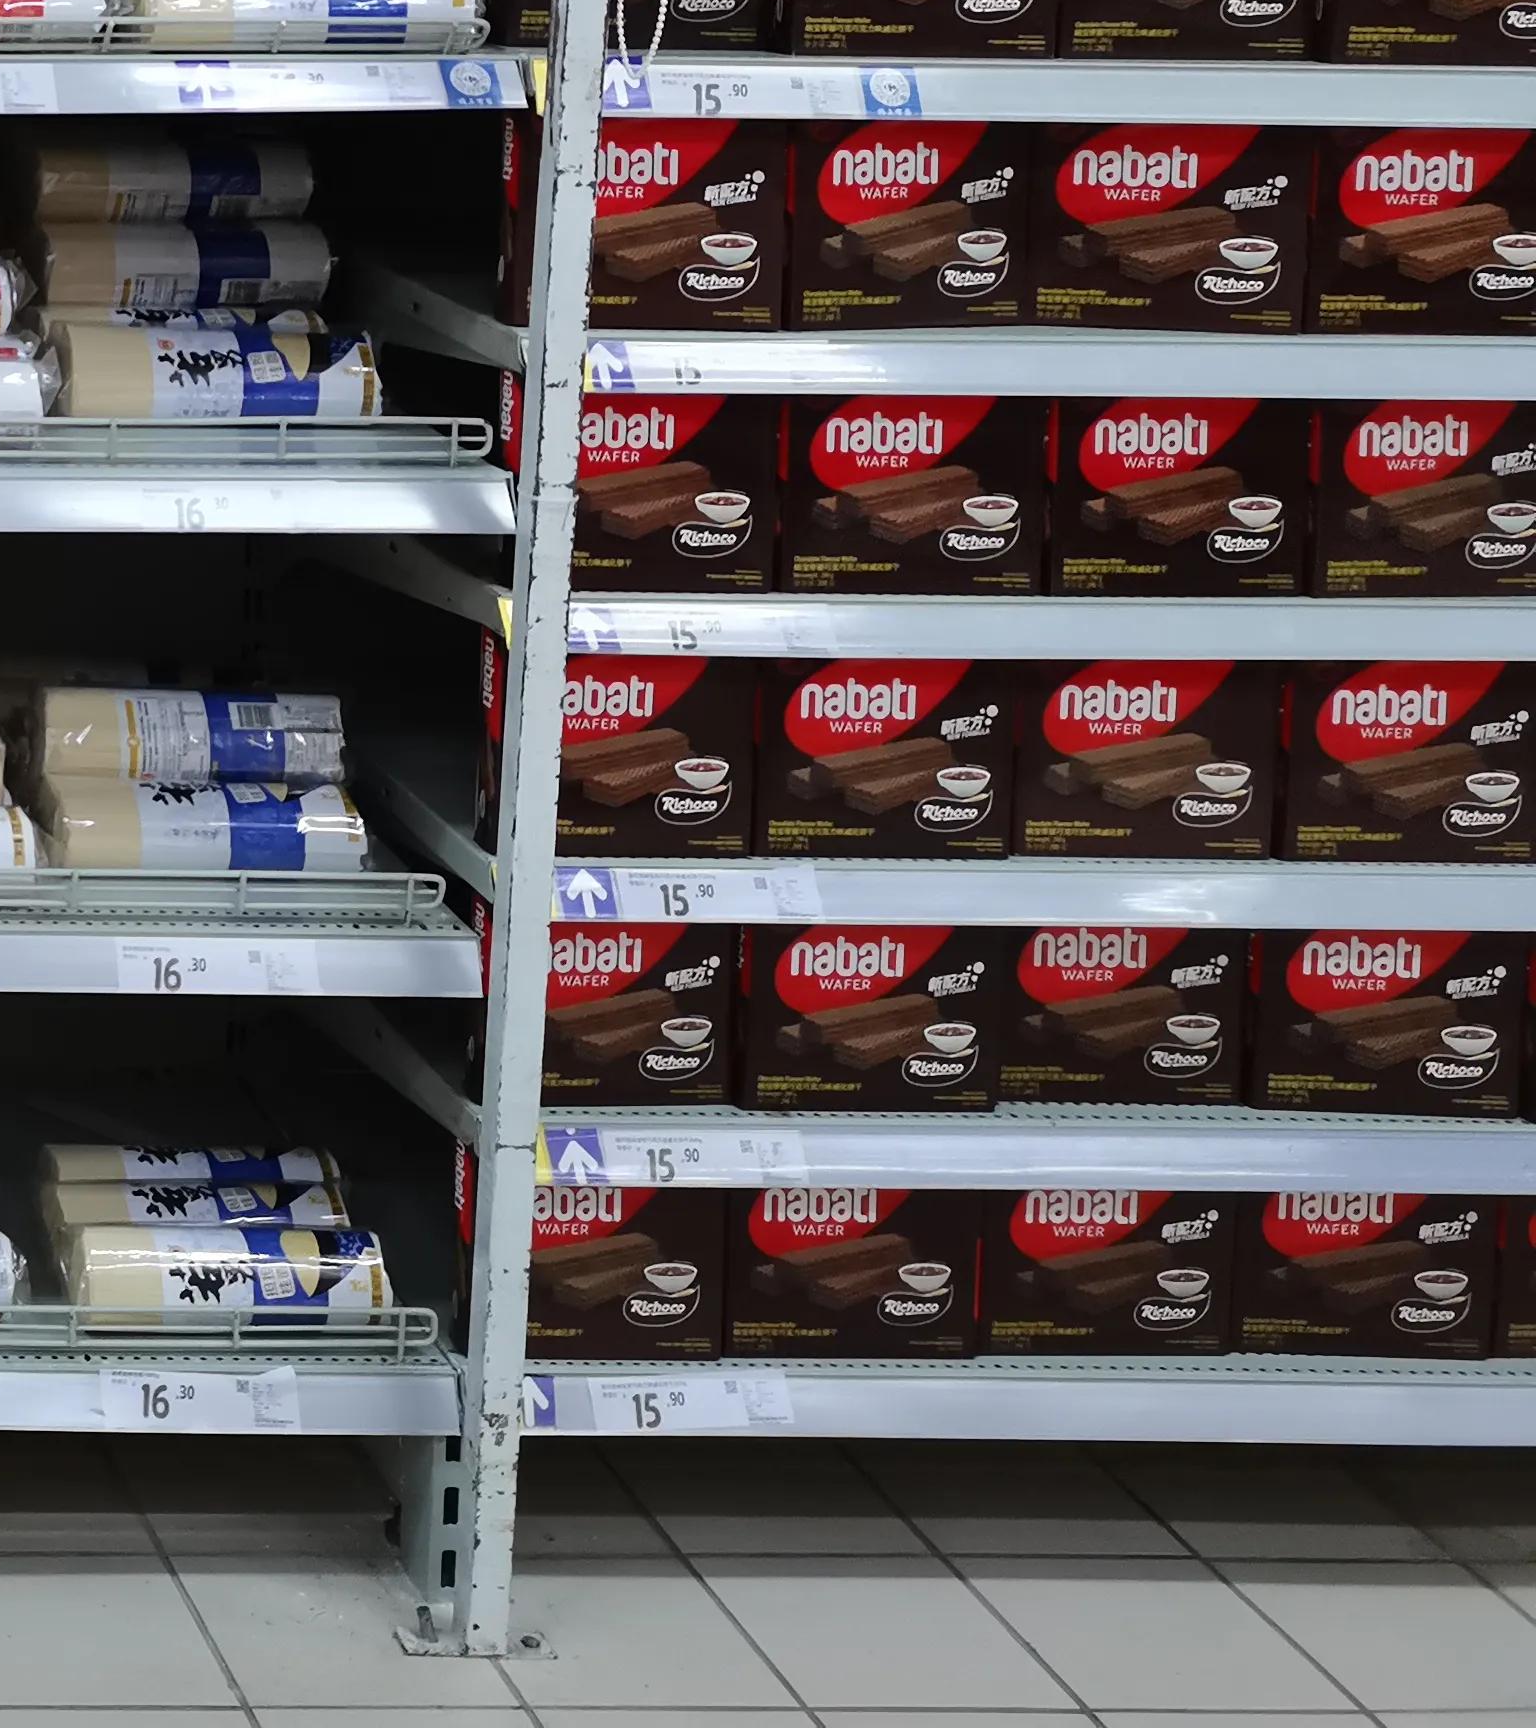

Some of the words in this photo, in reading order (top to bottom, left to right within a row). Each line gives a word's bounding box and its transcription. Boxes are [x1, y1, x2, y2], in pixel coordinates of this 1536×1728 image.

[1074, 148, 1198, 190] nabati
[1104, 188, 1161, 202] WAFER
[1204, 275, 1264, 293] Richoco
[826, 416, 943, 455] nabati
[855, 455, 909, 469] WAFER
[948, 532, 1006, 550] Richoco
[1060, 679, 1178, 723] nabati
[1088, 721, 1142, 735] WAFER
[791, 936, 905, 978] nabati
[820, 977, 871, 990] WAFER
[1427, 1060, 1486, 1078] Richoco
[1053, 1224, 1104, 1239] WAFER
[884, 1300, 941, 1319] Richoco
